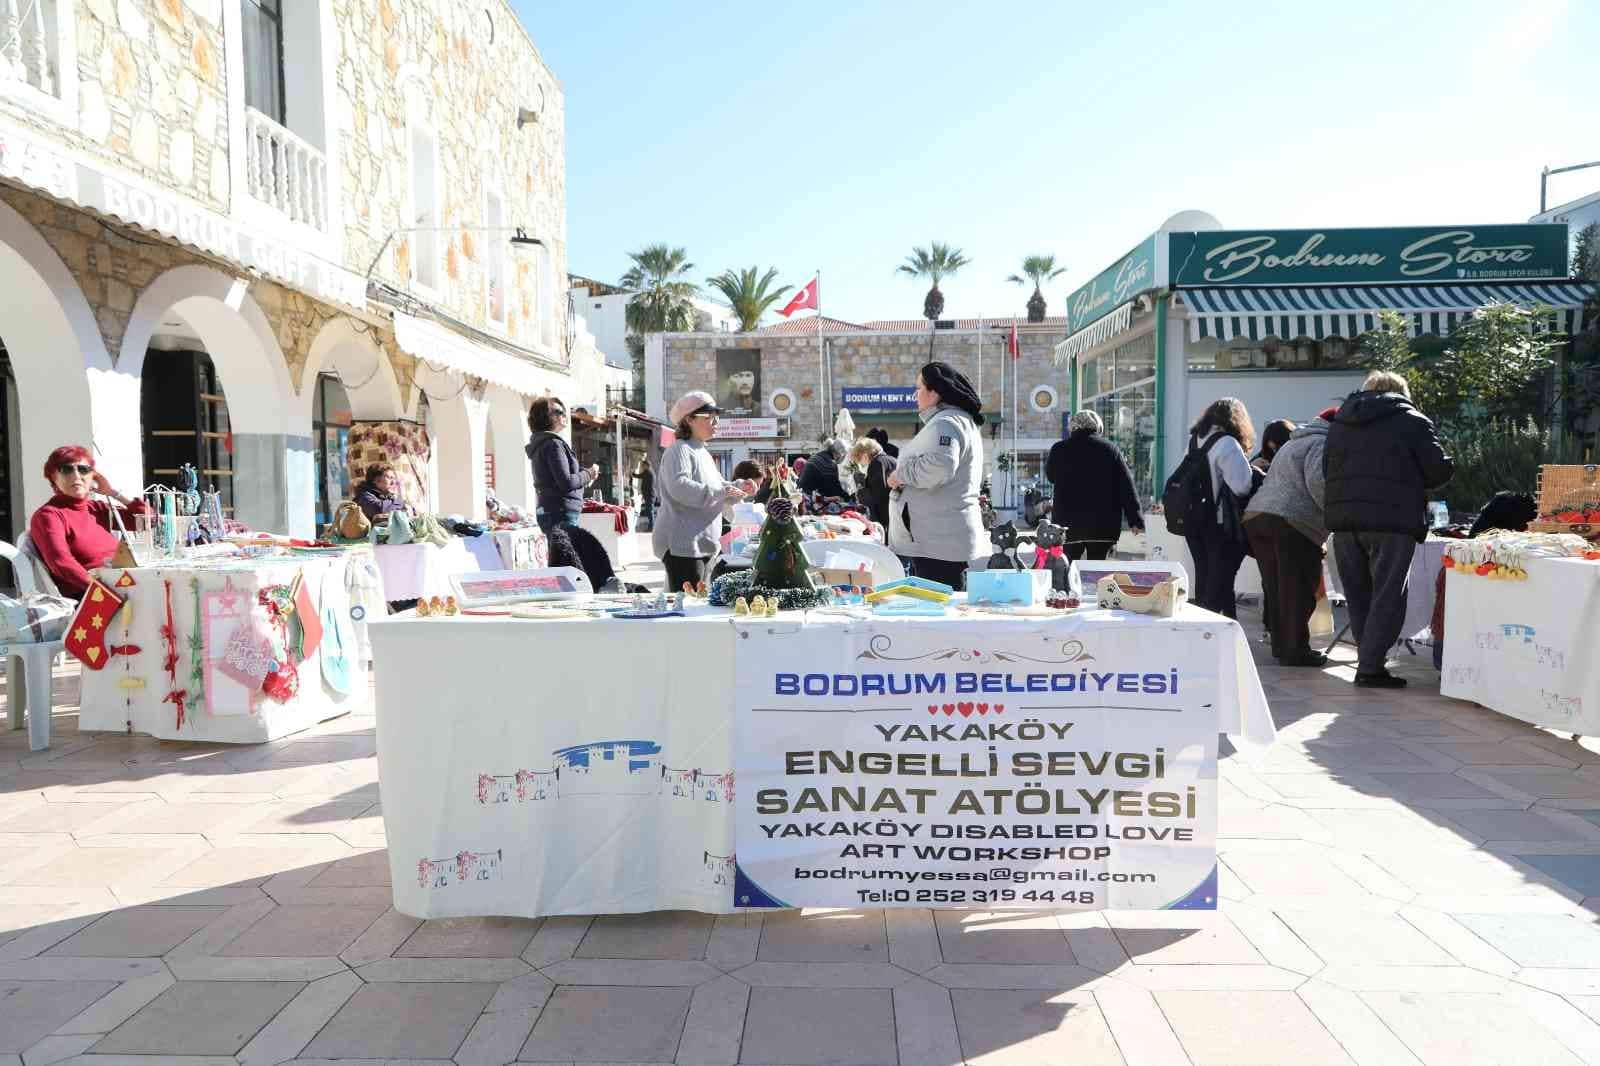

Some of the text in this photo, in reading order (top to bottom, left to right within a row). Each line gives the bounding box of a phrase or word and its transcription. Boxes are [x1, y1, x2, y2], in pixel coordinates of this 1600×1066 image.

[103, 180, 241, 258] BODRUM
[1205, 230, 1535, 282] Bodrum Store
[775, 668, 1179, 697] BODRUM BELEDİYESİ
[874, 719, 1074, 742] YAKAKÖY
[786, 746, 1166, 779] ENGELLİ SEVGİ
[756, 782, 1197, 819] SANAT ATÖLYESİ
[759, 819, 1194, 842] YAKAKÖY DISABLED LOVE
[840, 843, 1111, 862] ART WORKSHOP
[794, 866, 1156, 885] bodrumyessa@gmail.com
[915, 889, 966, 904] 252
[971, 888, 1018, 904] 319
[1022, 890, 1056, 904] 44
[1061, 890, 1095, 905] 48
